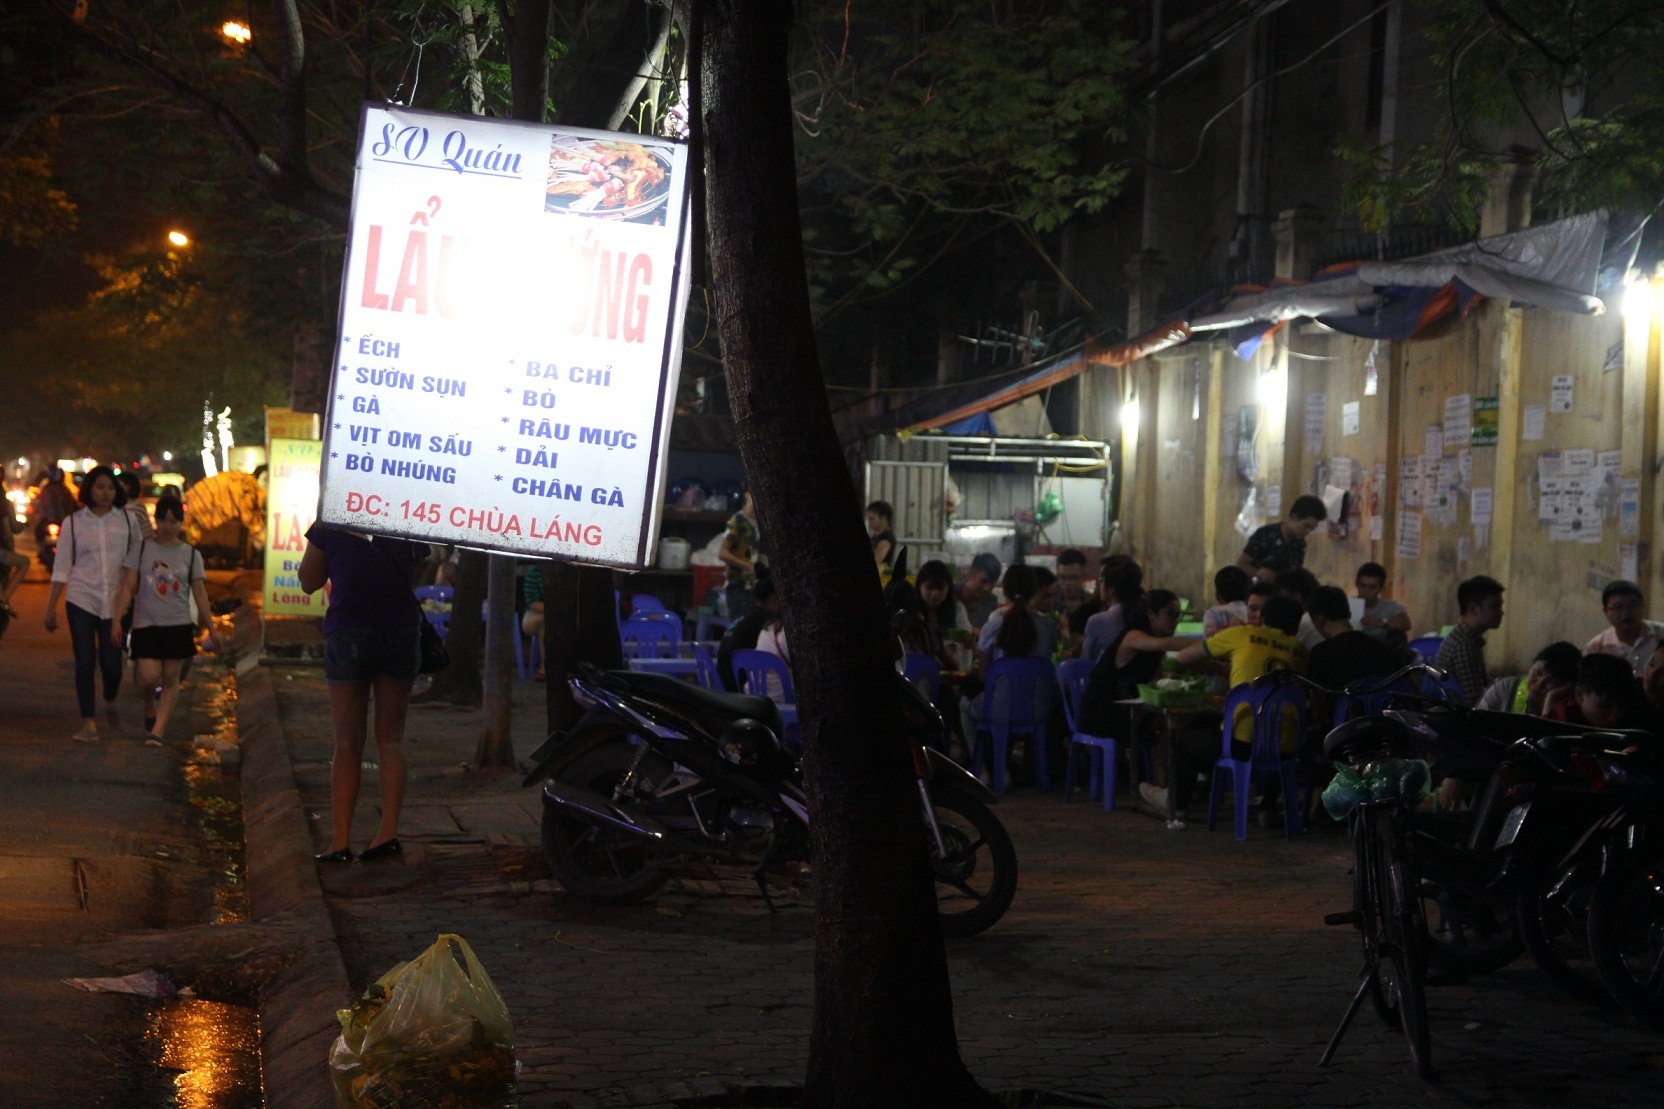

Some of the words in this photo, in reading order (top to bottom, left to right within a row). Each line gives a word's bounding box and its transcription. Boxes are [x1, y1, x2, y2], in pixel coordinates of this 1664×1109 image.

[441, 130, 523, 175] Quán
[358, 333, 400, 359] ẾCH
[355, 366, 415, 391] SƯỜN
[421, 375, 467, 399] SỤN
[526, 360, 559, 380] BA
[568, 364, 613, 388] CHỈ
[352, 394, 381, 416] GÀ
[522, 387, 557, 410] BÒ
[349, 424, 381, 447] VỊT
[387, 429, 422, 450] OM
[428, 432, 473, 457] SẤU
[518, 417, 571, 441] RÂU
[578, 426, 638, 451] MỰC
[345, 451, 375, 473] BÒ
[380, 458, 457, 485] NHÚNG
[515, 445, 559, 469] DẢI
[511, 476, 583, 502] CHÂN
[590, 485, 625, 508] GÀ
[345, 491, 391, 517] ĐC:
[400, 499, 442, 525] 145
[449, 506, 522, 536] CHÙA
[529, 515, 602, 547] LÁNG
